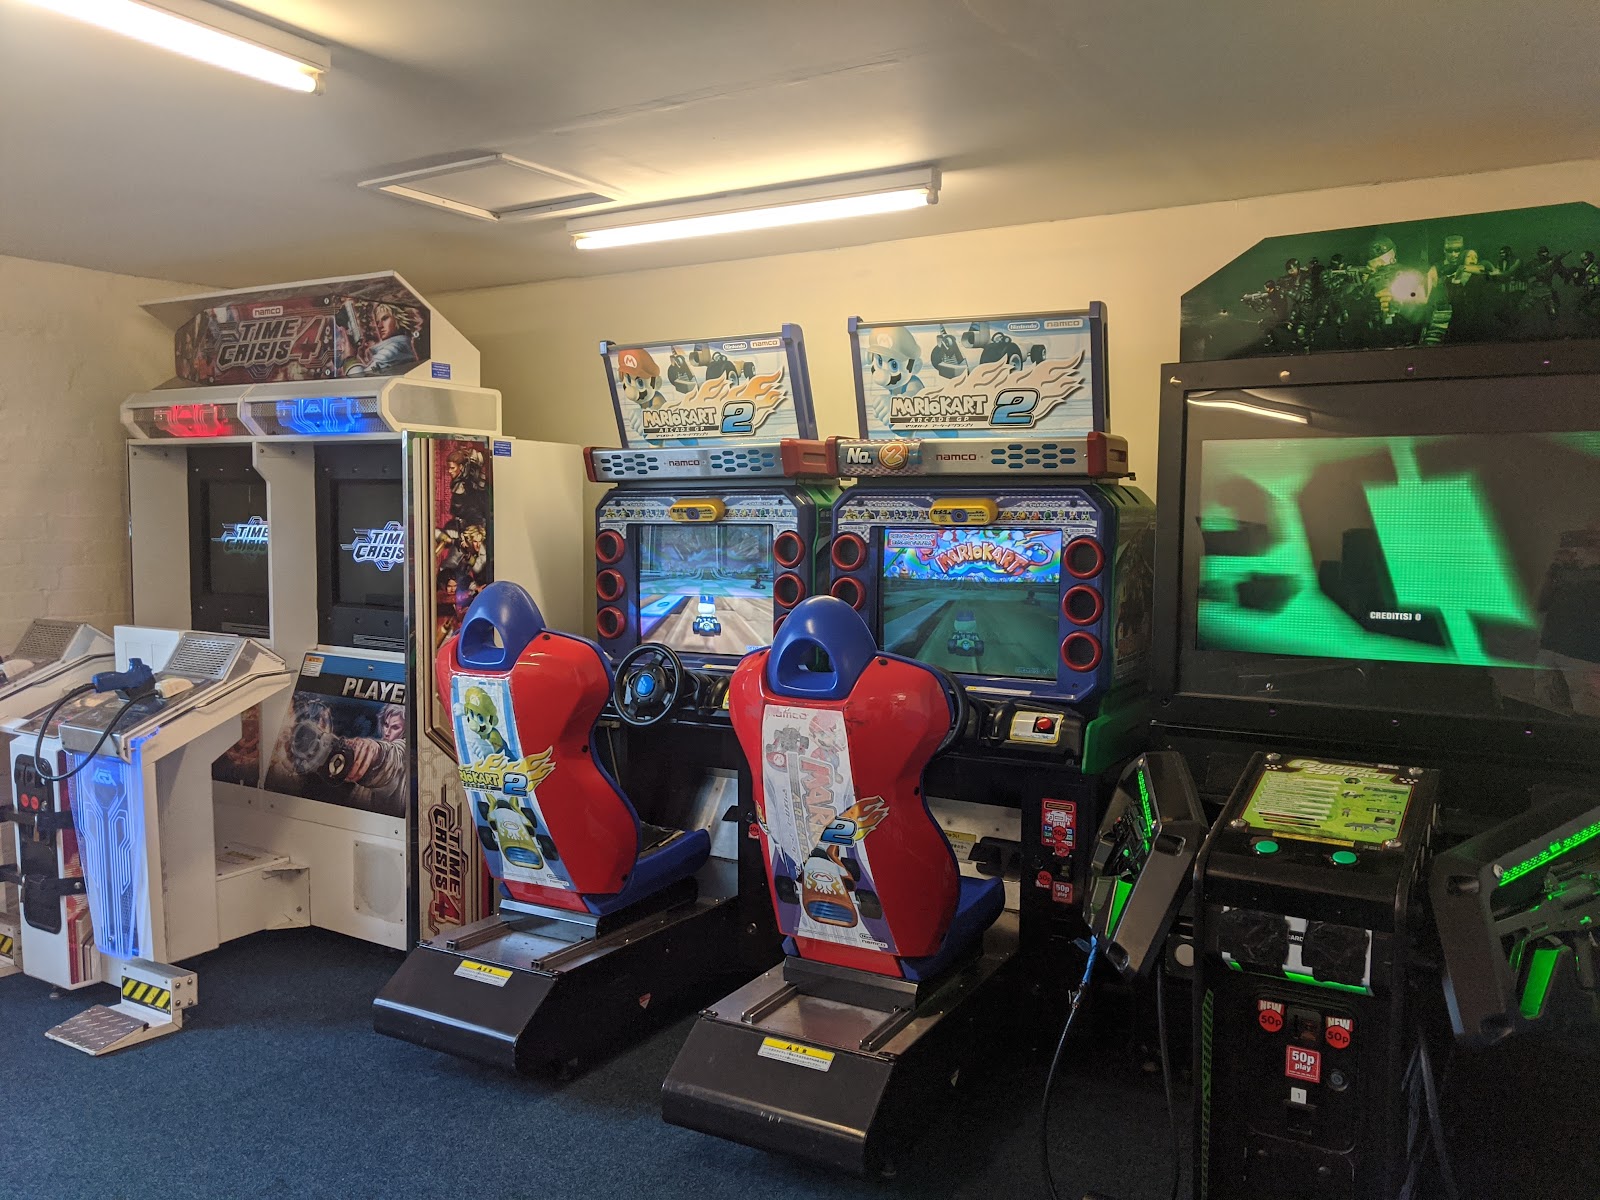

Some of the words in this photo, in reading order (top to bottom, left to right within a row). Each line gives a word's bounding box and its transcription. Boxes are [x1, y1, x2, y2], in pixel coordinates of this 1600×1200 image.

[254, 307, 282, 316] namco
[1046, 320, 1080, 328] namco
[240, 318, 300, 342] TIME
[290, 315, 325, 362] 4
[217, 340, 292, 367] CRISIS
[991, 389, 1039, 426] 2
[721, 401, 755, 434] 2
[668, 459, 700, 467] namco
[846, 447, 873, 465] No.
[935, 453, 977, 462] namco
[371, 531, 404, 545] TIM
[341, 677, 406, 704] PLAYE
[503, 771, 528, 797] 2
[433, 808, 448, 890] CRISIS
[448, 831, 461, 896] TIME
[1055, 884, 1070, 893] 50p
[434, 890, 461, 922] 4
[1262, 1016, 1281, 1027] 50p
[1328, 1032, 1348, 1044] 50p
[1292, 1051, 1315, 1065] 50p
[1295, 1063, 1312, 1073] play
